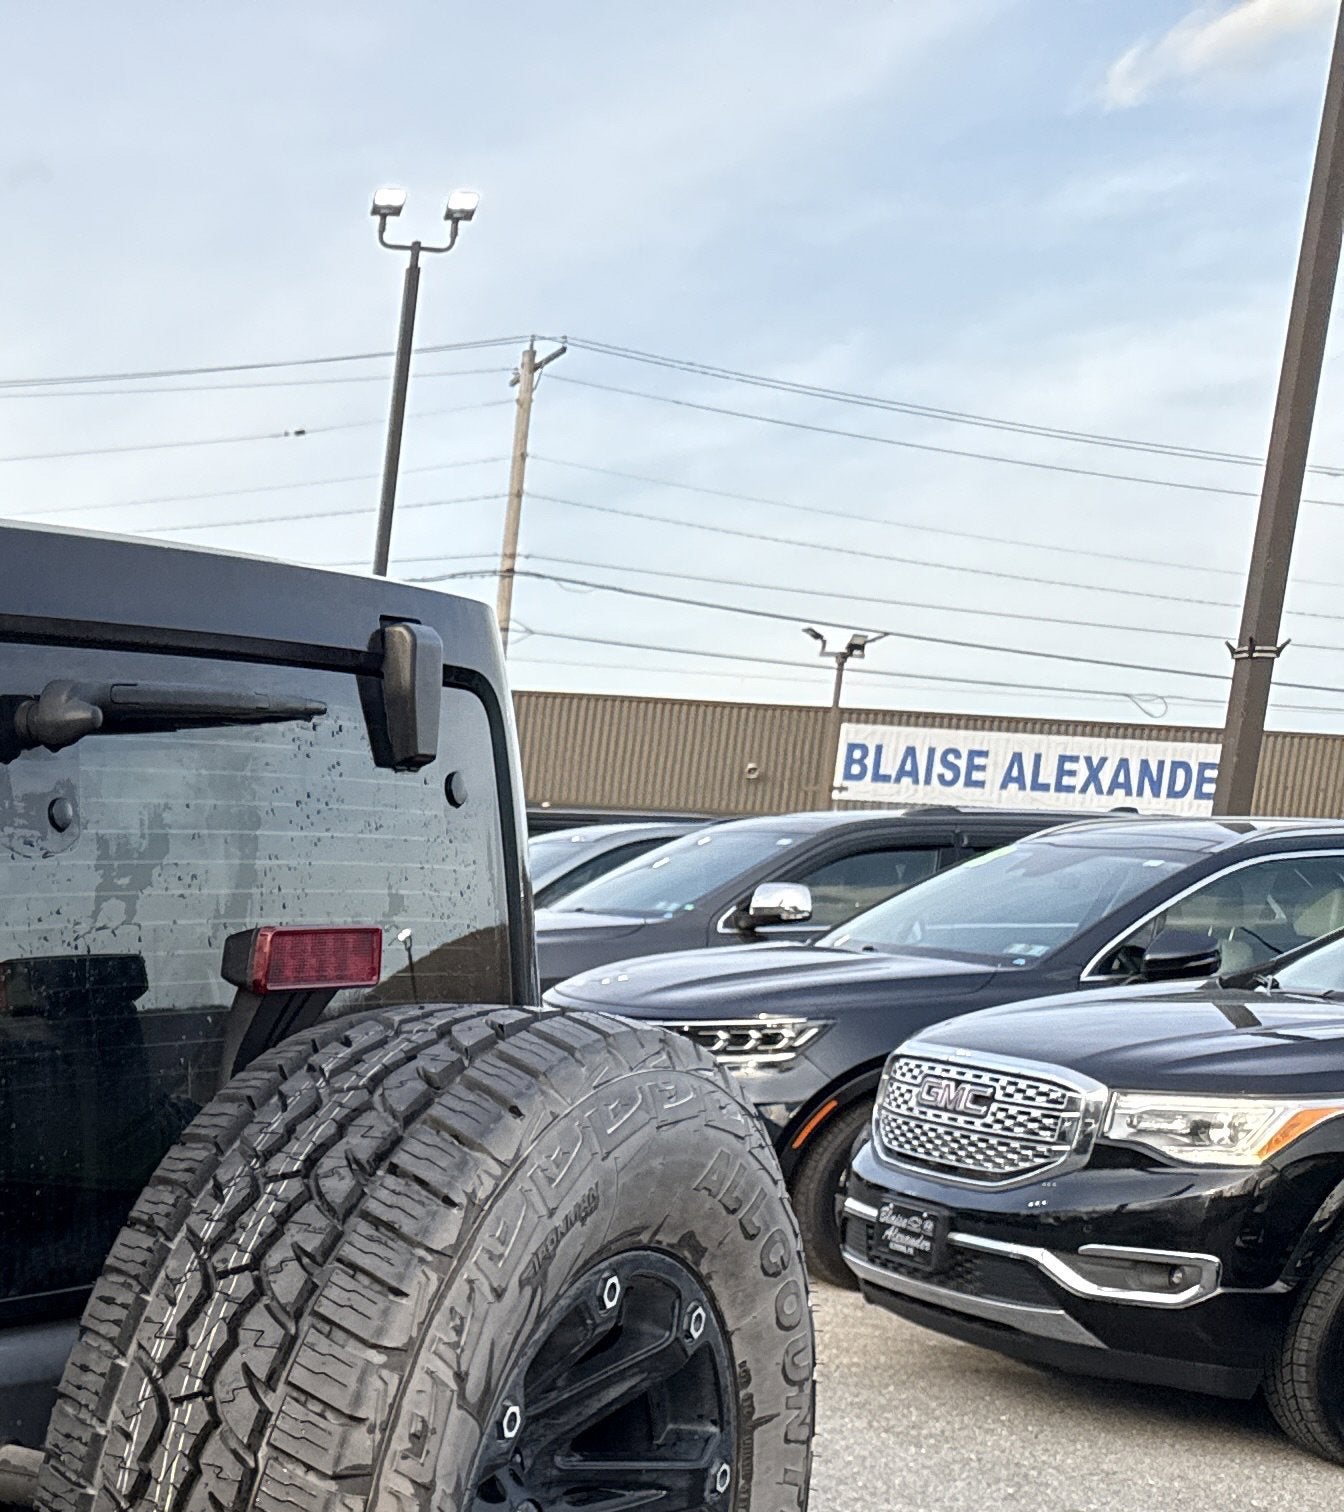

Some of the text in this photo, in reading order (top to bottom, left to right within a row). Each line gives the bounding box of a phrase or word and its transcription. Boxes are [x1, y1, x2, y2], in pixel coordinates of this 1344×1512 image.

[842, 742, 1219, 802] BLAISE ALEXANDE
[916, 1076, 994, 1116] GMC
[692, 1148, 768, 1241] ALL
